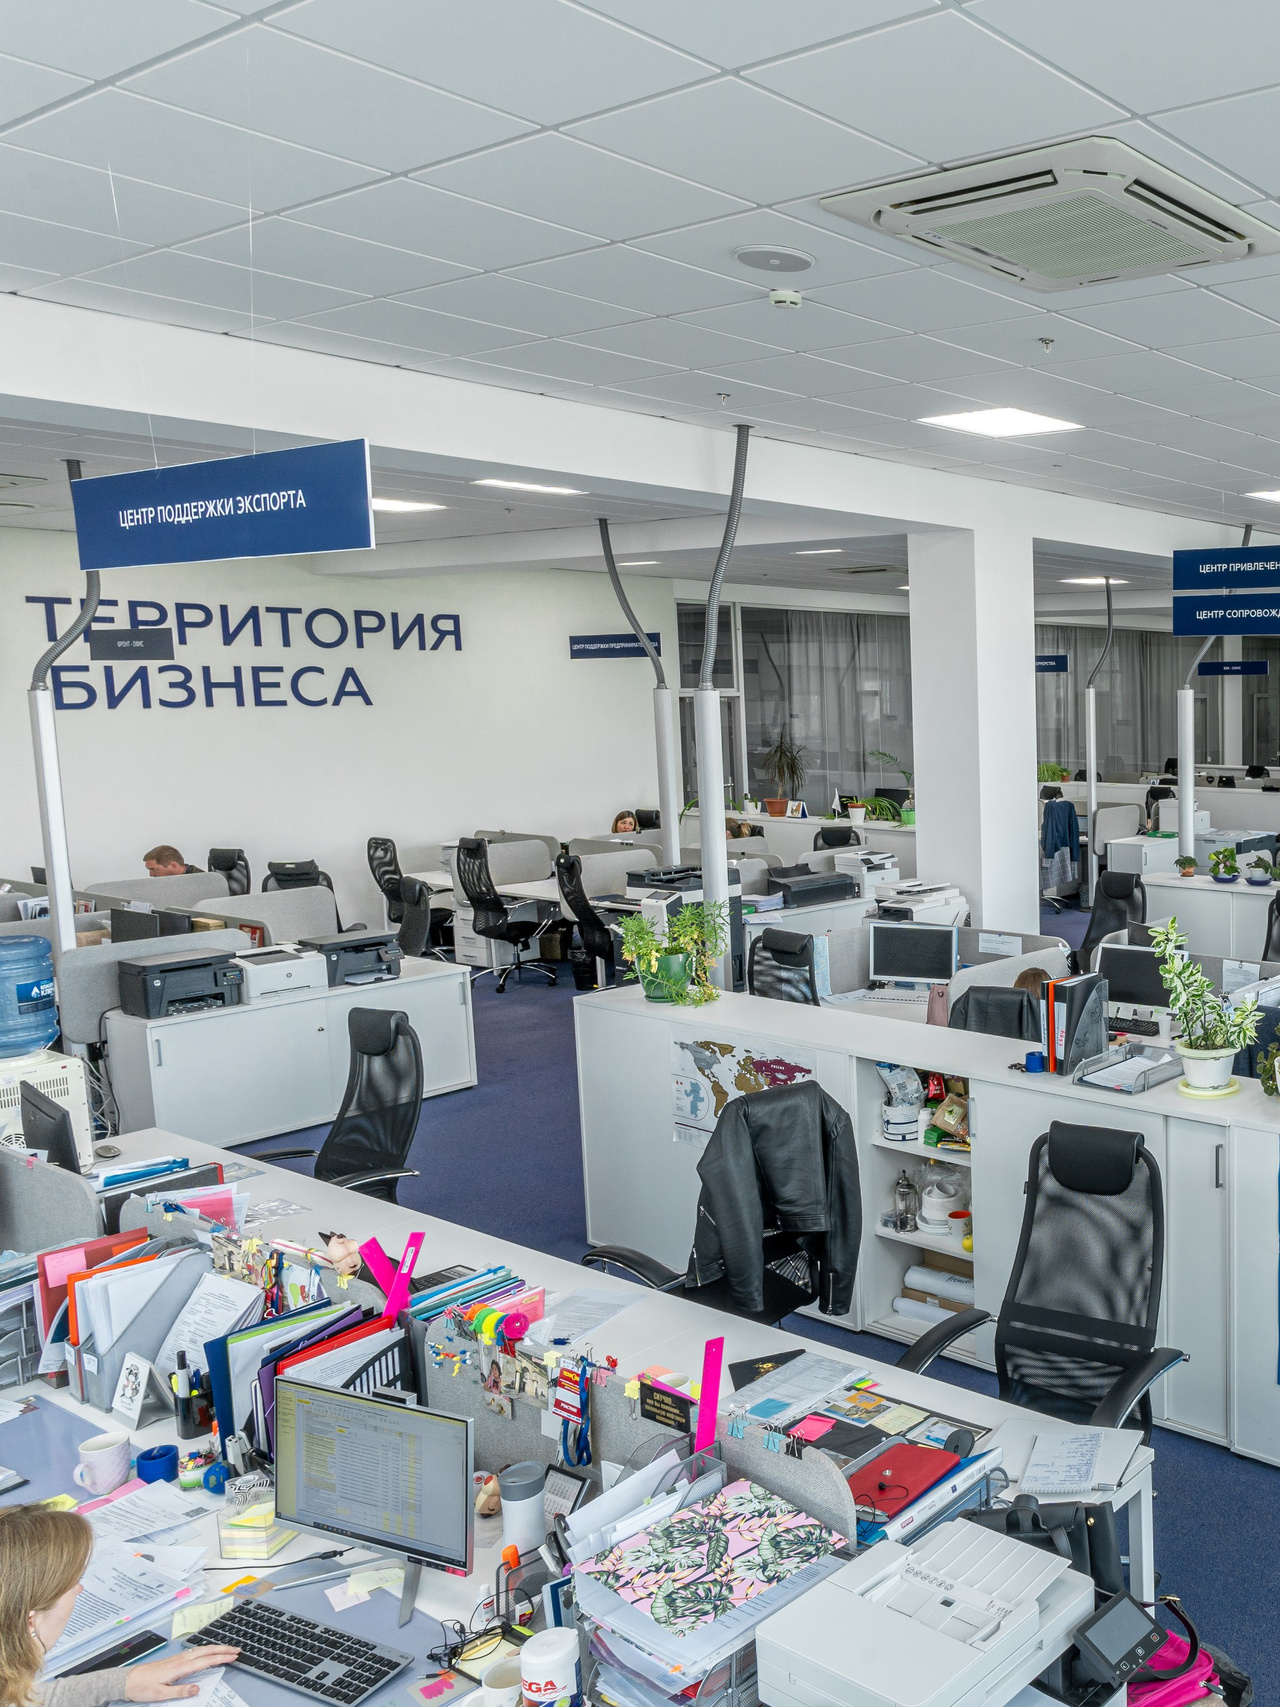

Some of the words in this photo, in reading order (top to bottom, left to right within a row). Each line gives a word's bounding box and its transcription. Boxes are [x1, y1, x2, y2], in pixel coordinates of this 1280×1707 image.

[118, 505, 155, 529] ЦЕНТР
[157, 498, 234, 526] ПОДДЕРЖКИ
[236, 489, 306, 515] ЭКСПОРТА
[1199, 563, 1228, 573] ЦЕНТР
[1196, 610, 1224, 620] ЦЕНТР
[51, 665, 374, 709] БИЗНЕСА
[522, 1680, 557, 1693] EGA
